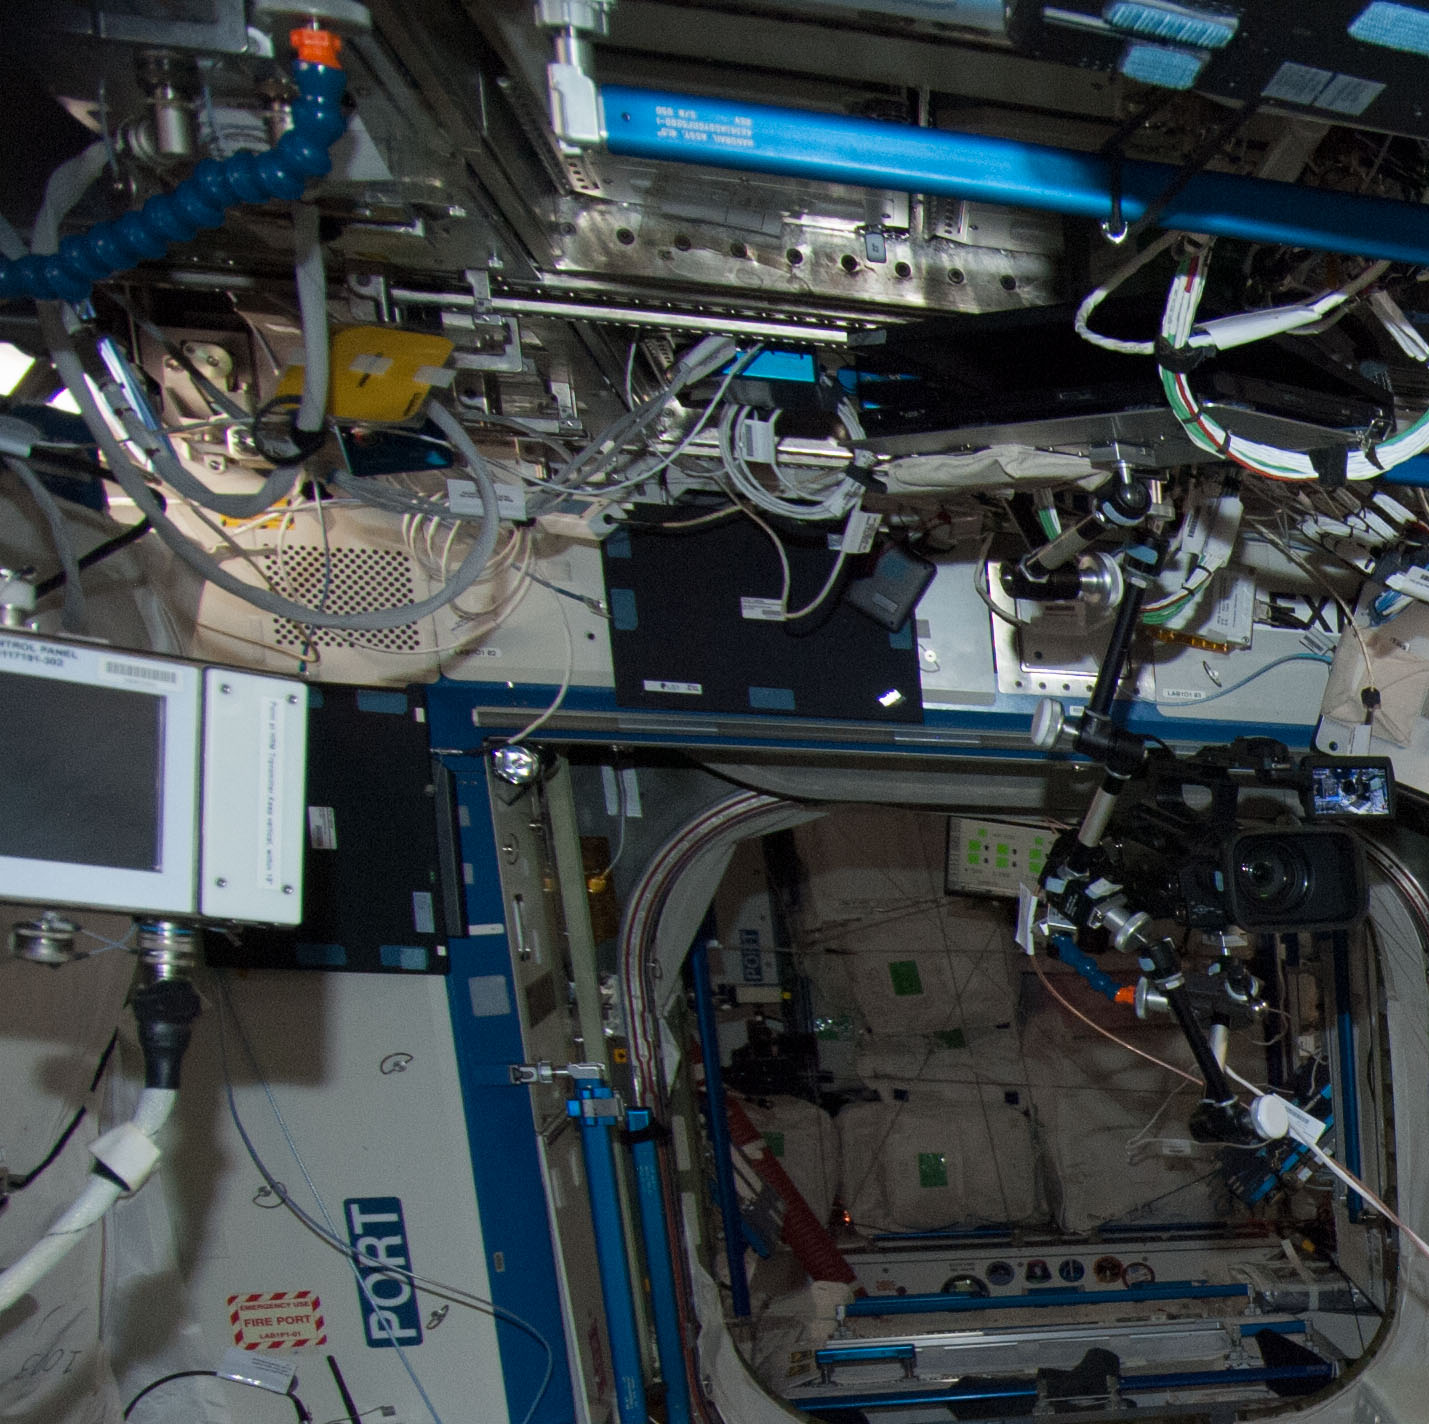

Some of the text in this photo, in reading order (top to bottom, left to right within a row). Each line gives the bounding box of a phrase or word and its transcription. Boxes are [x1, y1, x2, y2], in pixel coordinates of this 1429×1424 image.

[41, 645, 78, 660] PANEL
[350, 1203, 418, 1340] PORT
[239, 1301, 310, 1312] EMERGENCY USE
[243, 1314, 312, 1328] FIRE PORT
